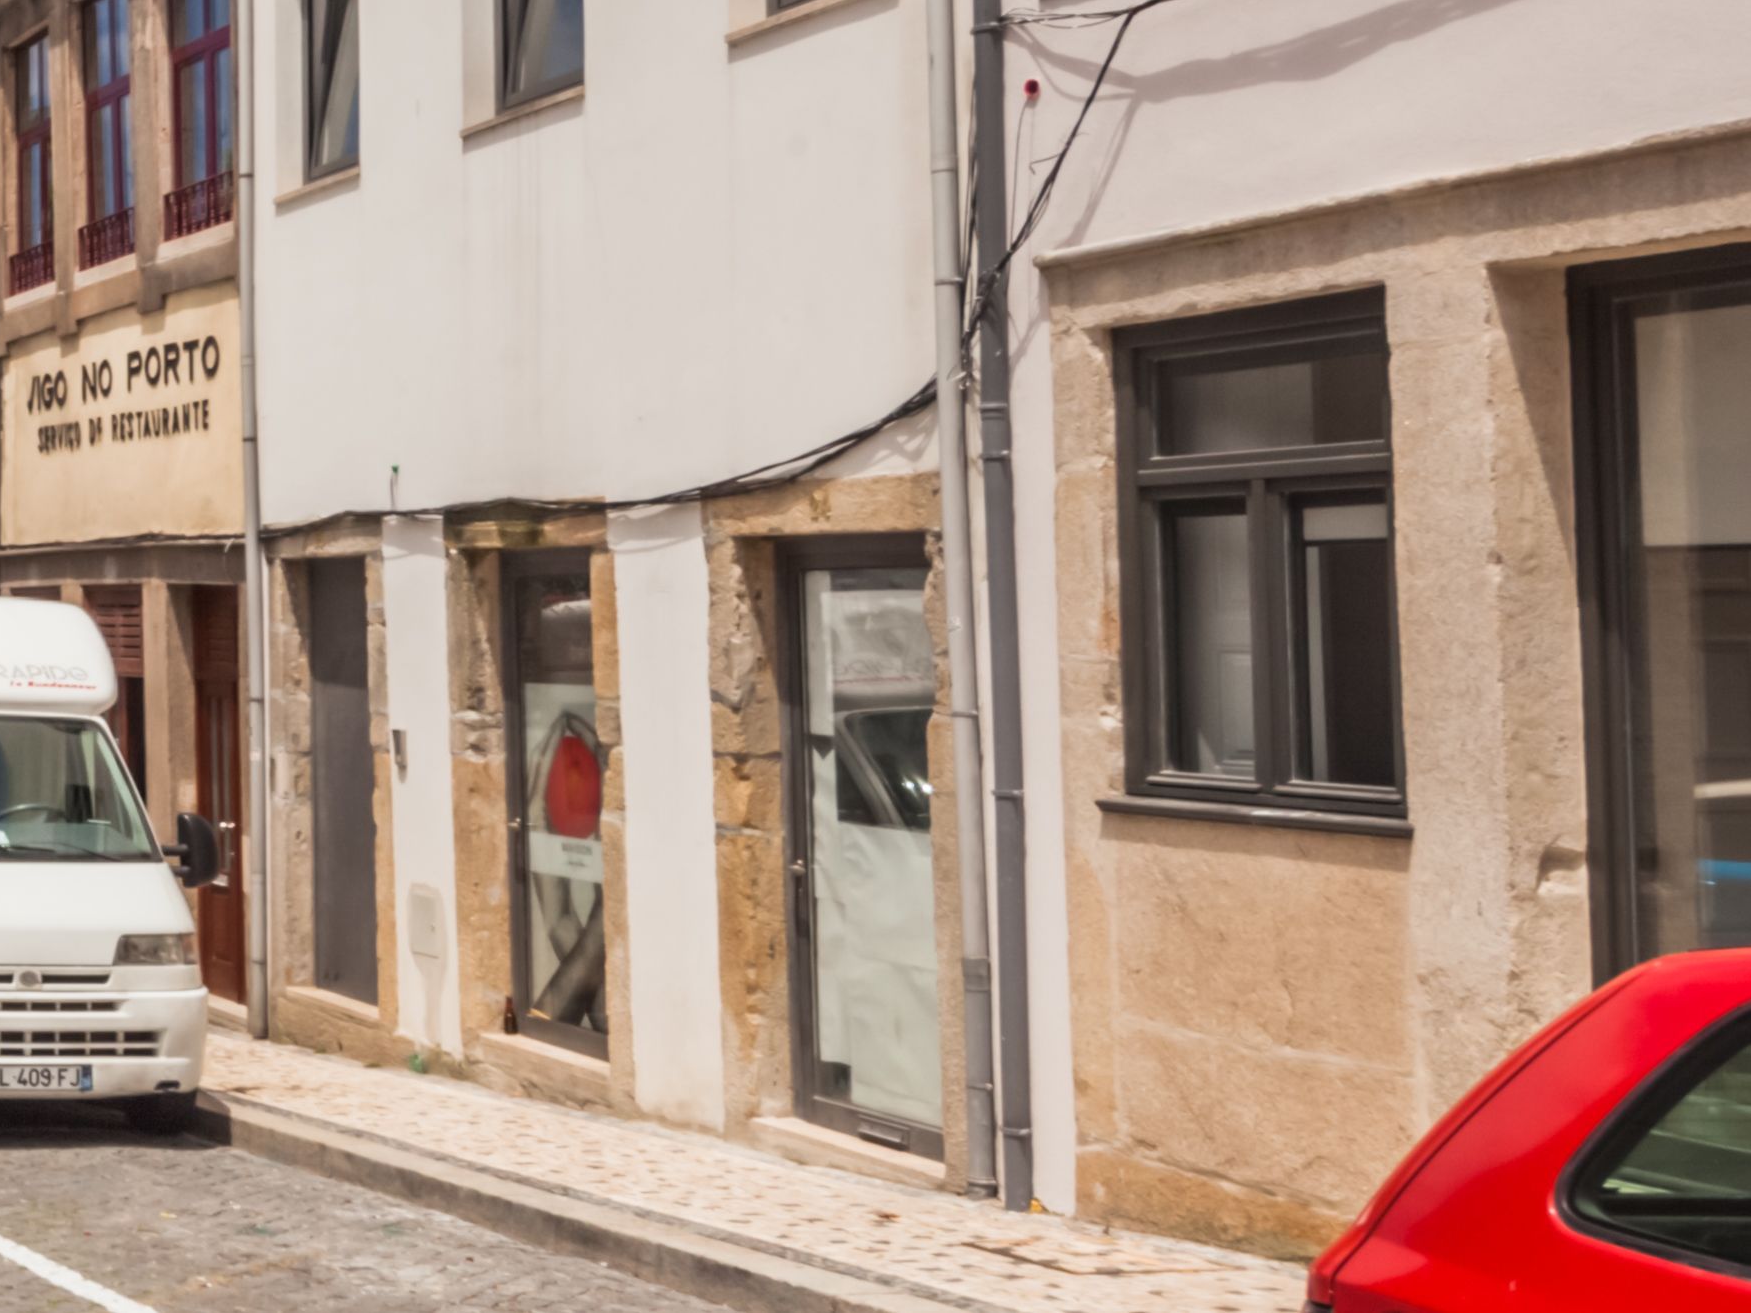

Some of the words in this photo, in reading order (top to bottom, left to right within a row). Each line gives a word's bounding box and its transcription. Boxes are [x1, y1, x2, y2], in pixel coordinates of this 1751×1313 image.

[81, 359, 113, 404] NO
[126, 335, 220, 393] PORTO
[111, 399, 210, 442] RESTAURANTE
